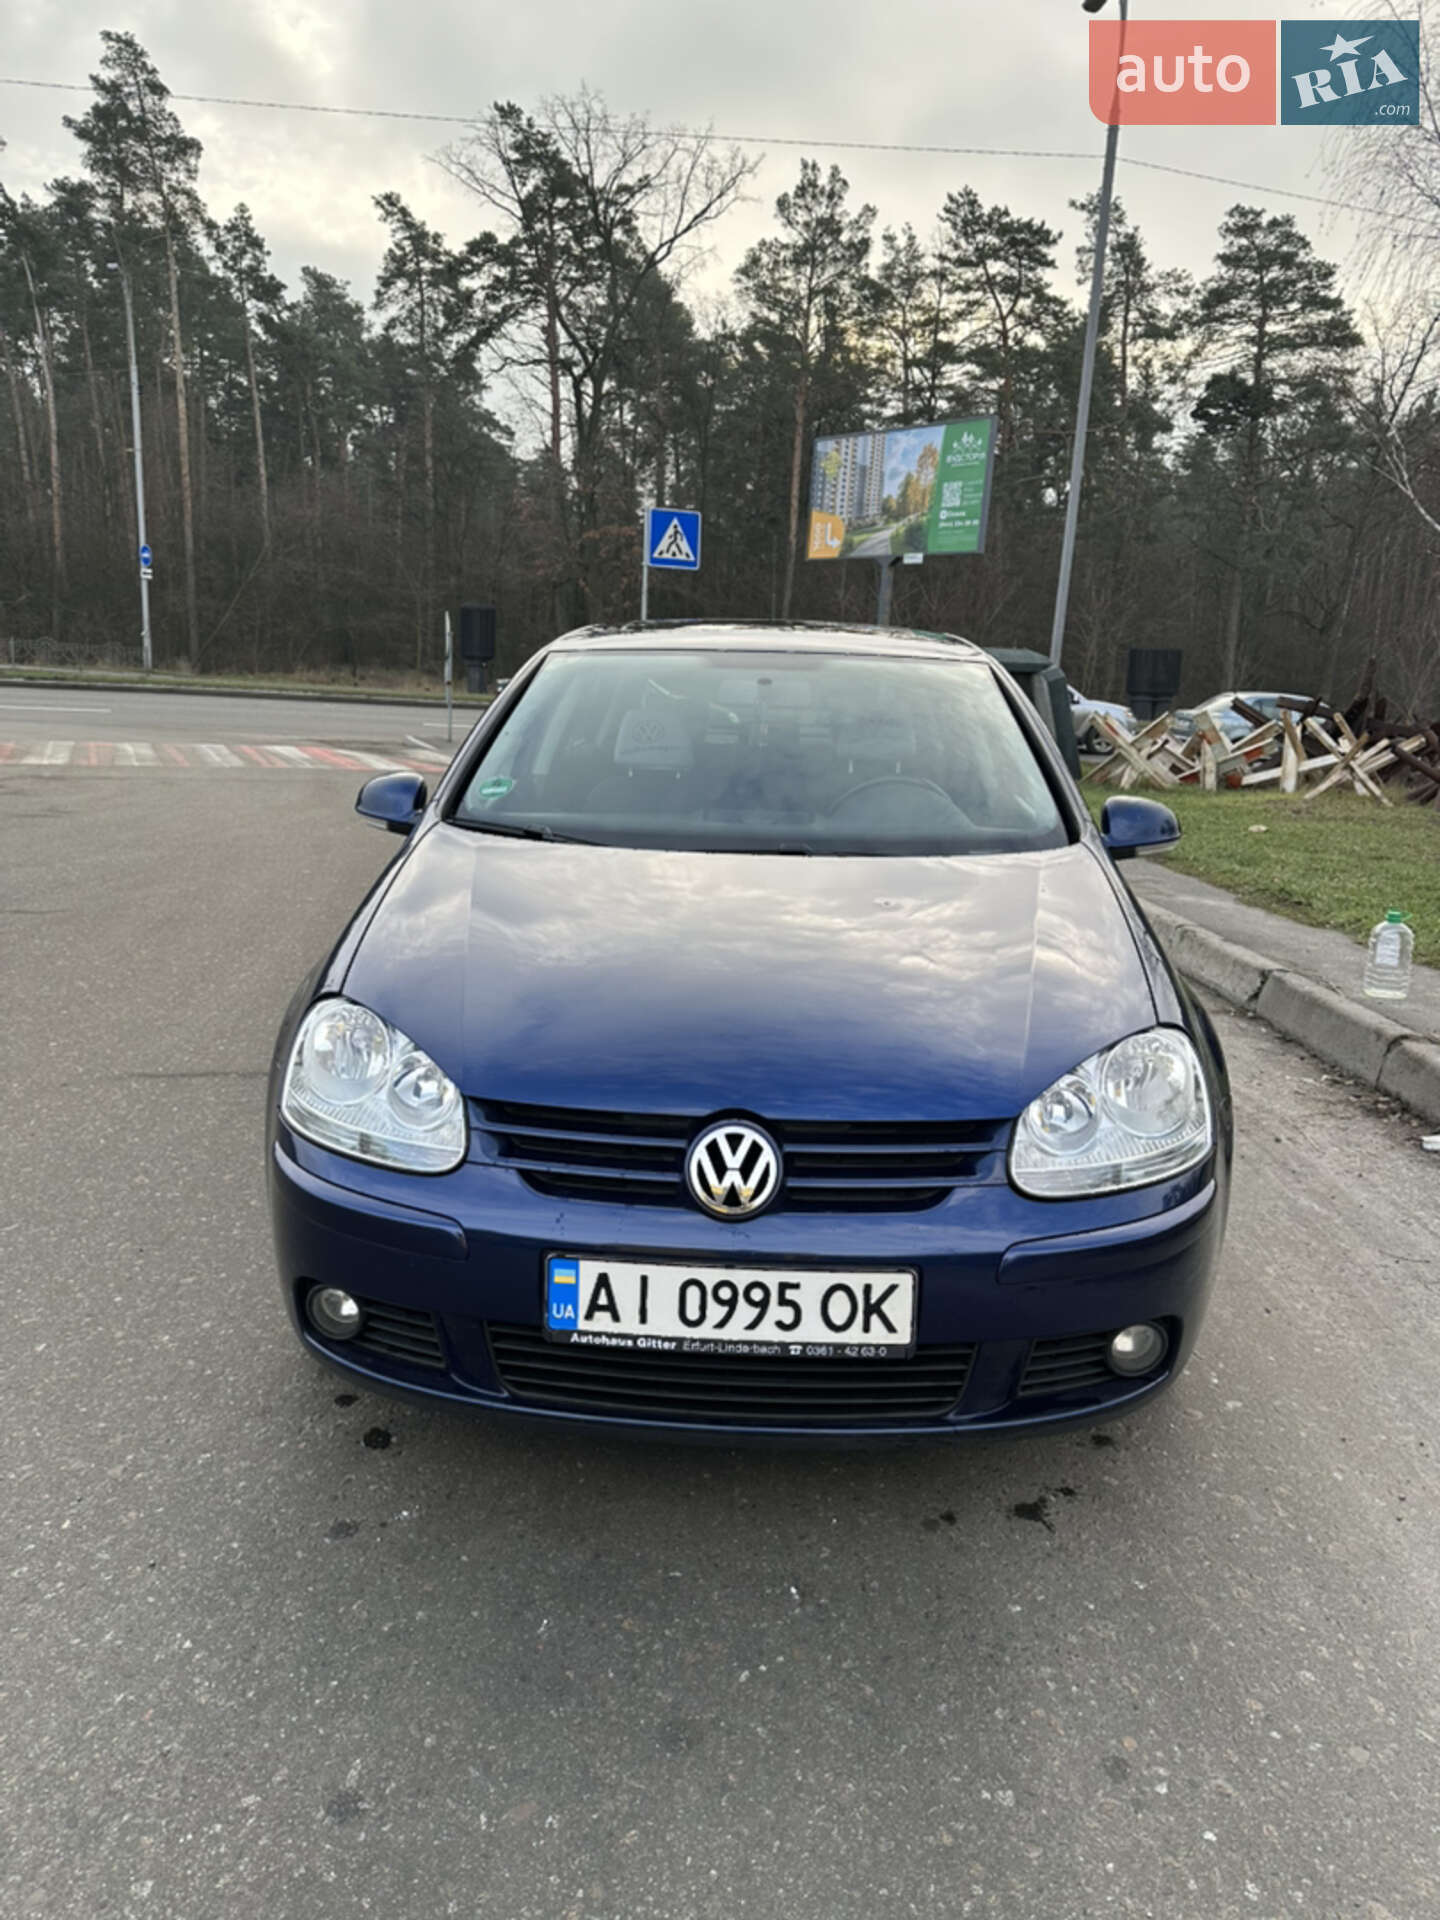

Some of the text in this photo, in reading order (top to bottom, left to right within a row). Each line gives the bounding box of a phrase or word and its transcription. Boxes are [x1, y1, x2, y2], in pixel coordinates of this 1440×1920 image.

[690, 1126, 778, 1214] VW
[552, 1304, 576, 1319] UA
[678, 1278, 802, 1332] 0995
[820, 1283, 899, 1333] OK
[570, 1332, 633, 1347] Autohaus
[636, 1337, 677, 1350] Gitter
